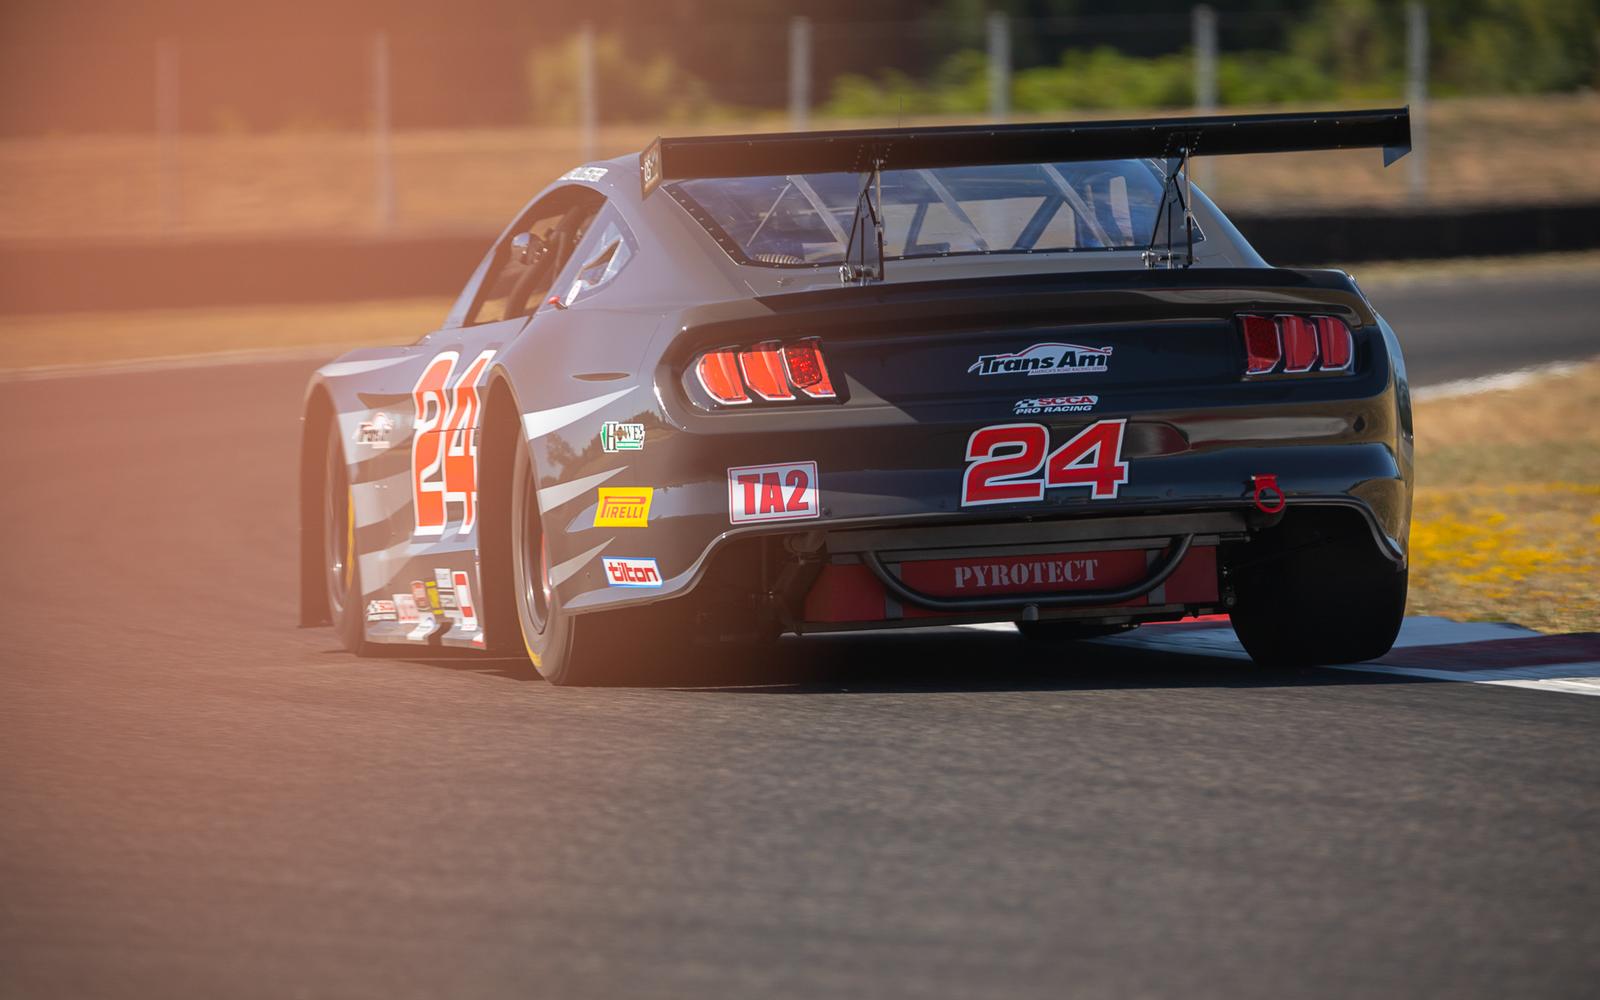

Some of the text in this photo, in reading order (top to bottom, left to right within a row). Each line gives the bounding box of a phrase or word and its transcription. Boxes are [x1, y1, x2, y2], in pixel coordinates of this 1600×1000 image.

[980, 350, 1106, 374] Trans Am
[1015, 405, 1093, 415] PRO RACING
[1039, 396, 1094, 406] SCCA
[411, 350, 497, 536] 24
[961, 419, 1129, 507] 24
[737, 469, 809, 515] TA2
[600, 495, 646, 518] PIRELLI
[608, 561, 658, 583] tilton
[954, 559, 1099, 588] PYROTECT
